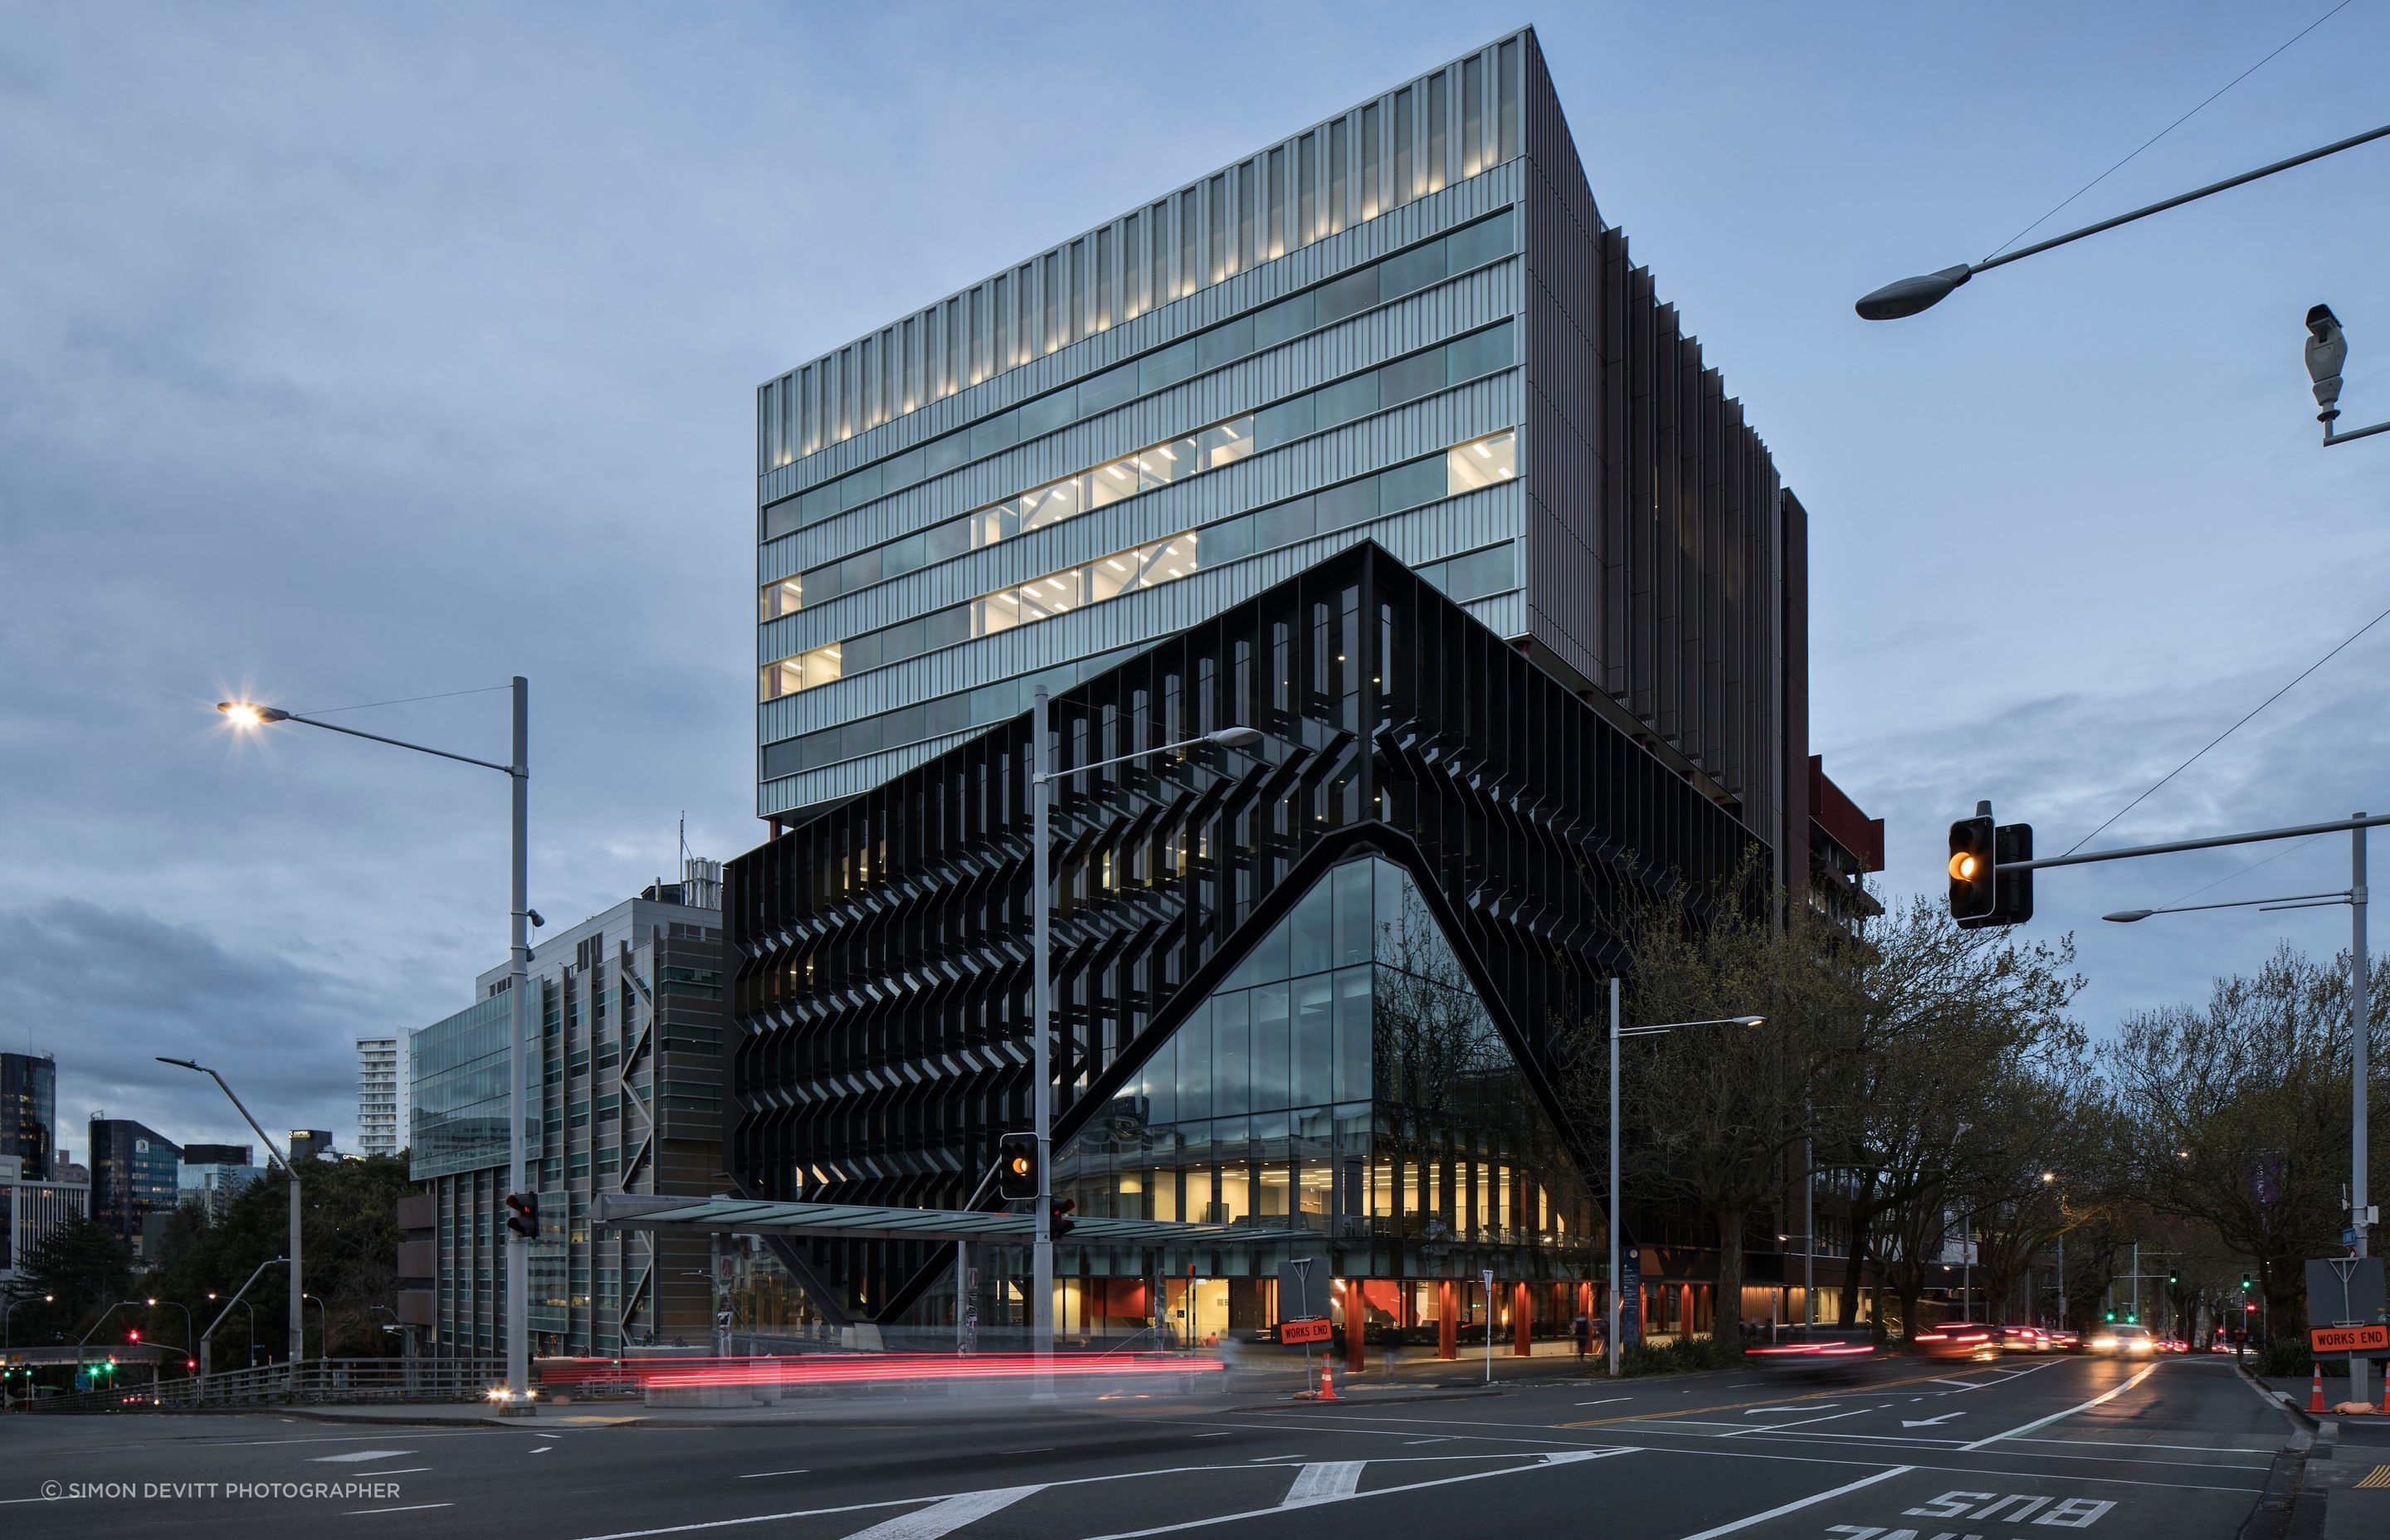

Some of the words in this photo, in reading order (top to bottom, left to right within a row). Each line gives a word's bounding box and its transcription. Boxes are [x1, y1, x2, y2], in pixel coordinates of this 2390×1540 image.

[1285, 1327, 1310, 1338] WORKS
[1314, 1325, 1328, 1336] END
[2318, 1333, 2355, 1345] WORKS
[2361, 1332, 2382, 1343] END
[1900, 1490, 2118, 1528] BUS
